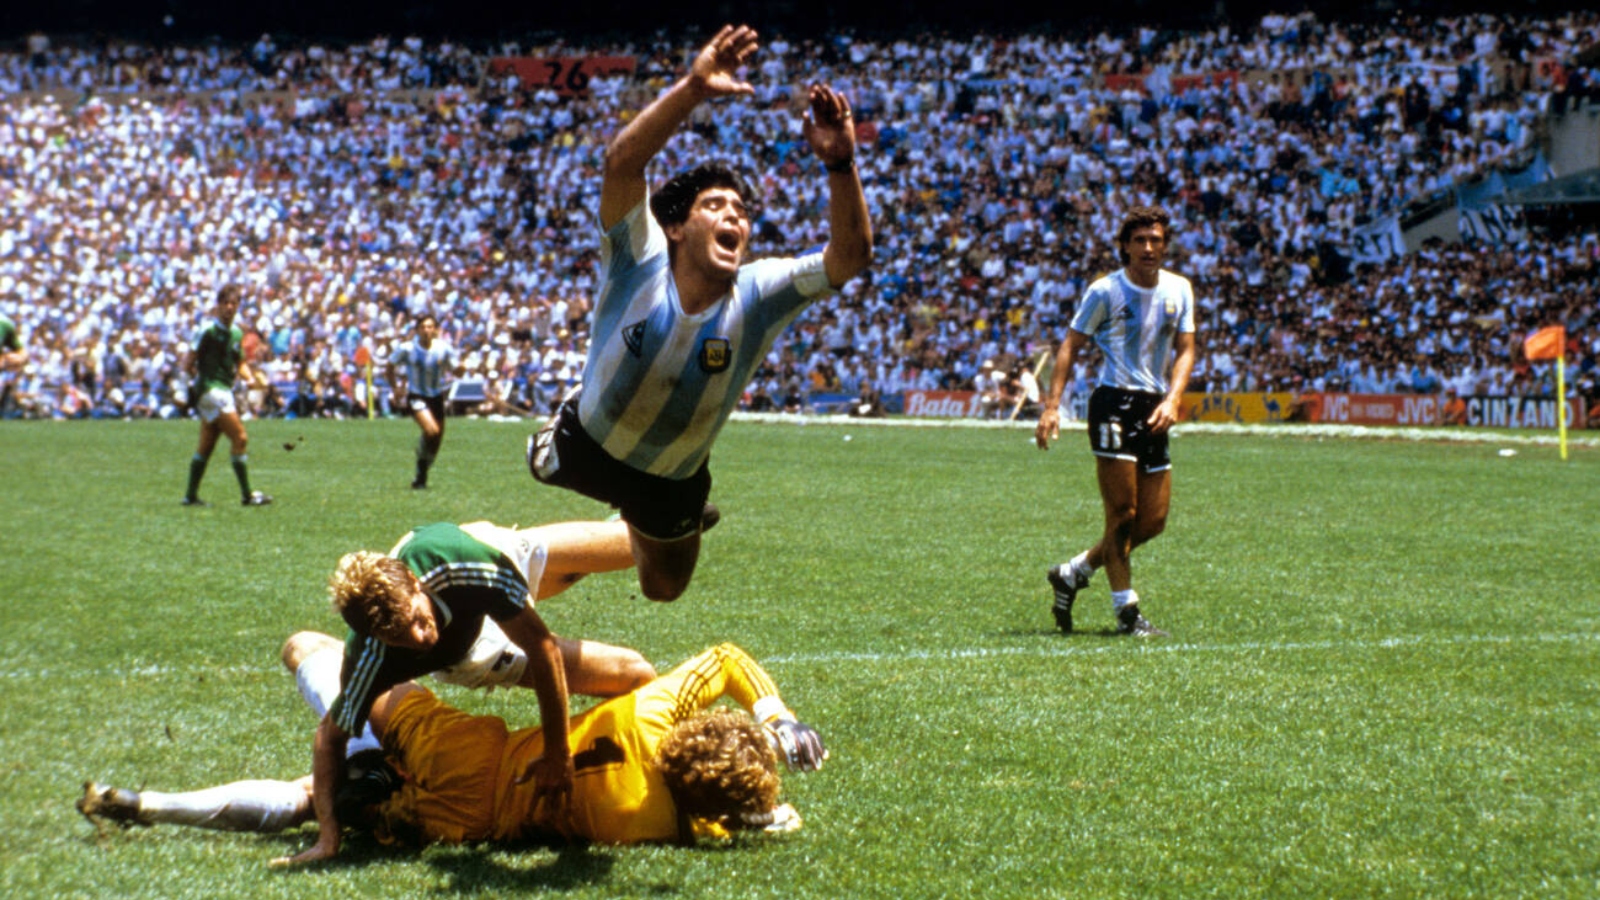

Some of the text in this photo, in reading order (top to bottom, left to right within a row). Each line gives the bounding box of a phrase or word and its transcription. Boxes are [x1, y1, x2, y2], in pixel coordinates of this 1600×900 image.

[544, 60, 589, 91] 26
[906, 393, 965, 417] Bata
[1190, 396, 1244, 423] CAMEL
[1321, 395, 1349, 421] JVC
[1397, 397, 1434, 424] JVC
